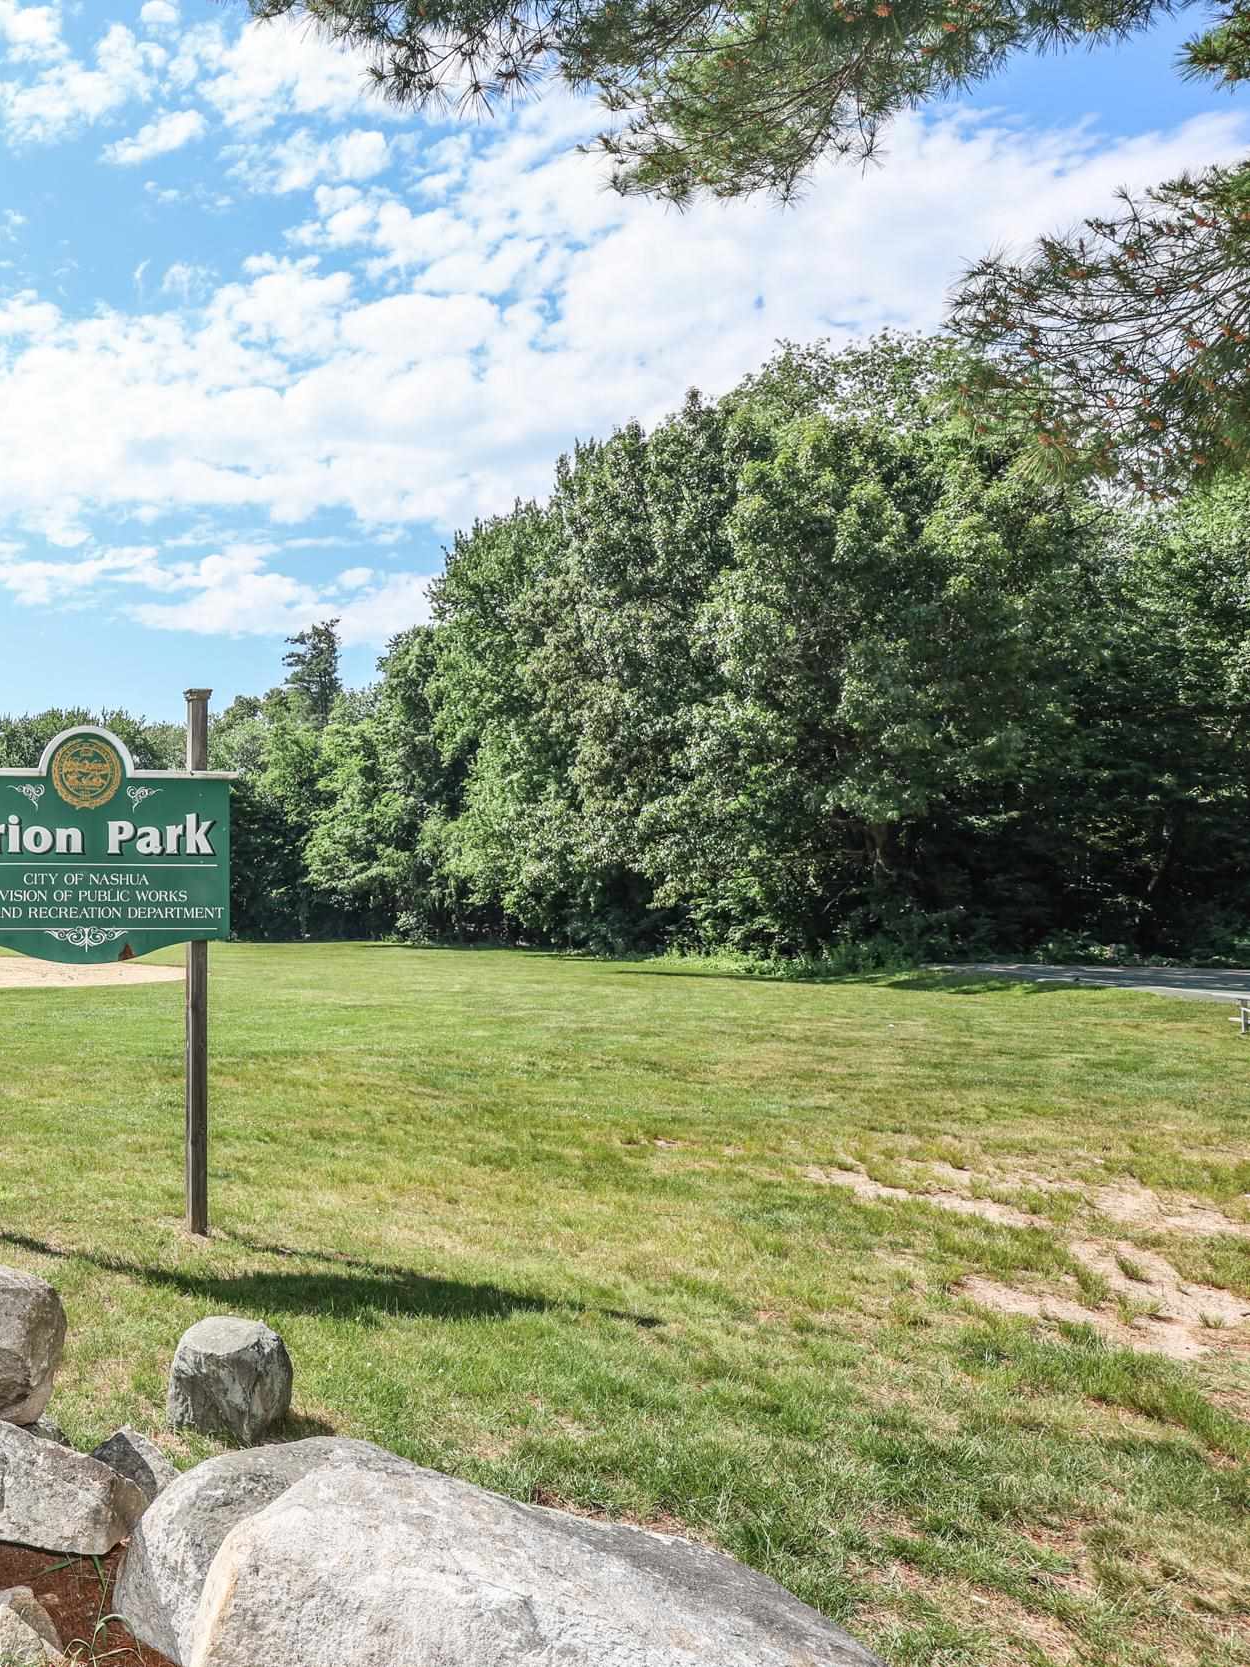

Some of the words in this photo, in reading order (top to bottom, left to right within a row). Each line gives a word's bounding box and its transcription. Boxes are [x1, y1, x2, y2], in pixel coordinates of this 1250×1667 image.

[107, 813, 217, 856] Park
[23, 872, 58, 886] CITY
[64, 872, 84, 886] OF
[89, 872, 149, 886] NASHUA
[53, 889, 73, 902] OF
[78, 889, 131, 902] PUBLIC
[135, 889, 188, 902] WORKS
[28, 906, 122, 919] RECREATION
[127, 906, 224, 919] DEPARTMENT
